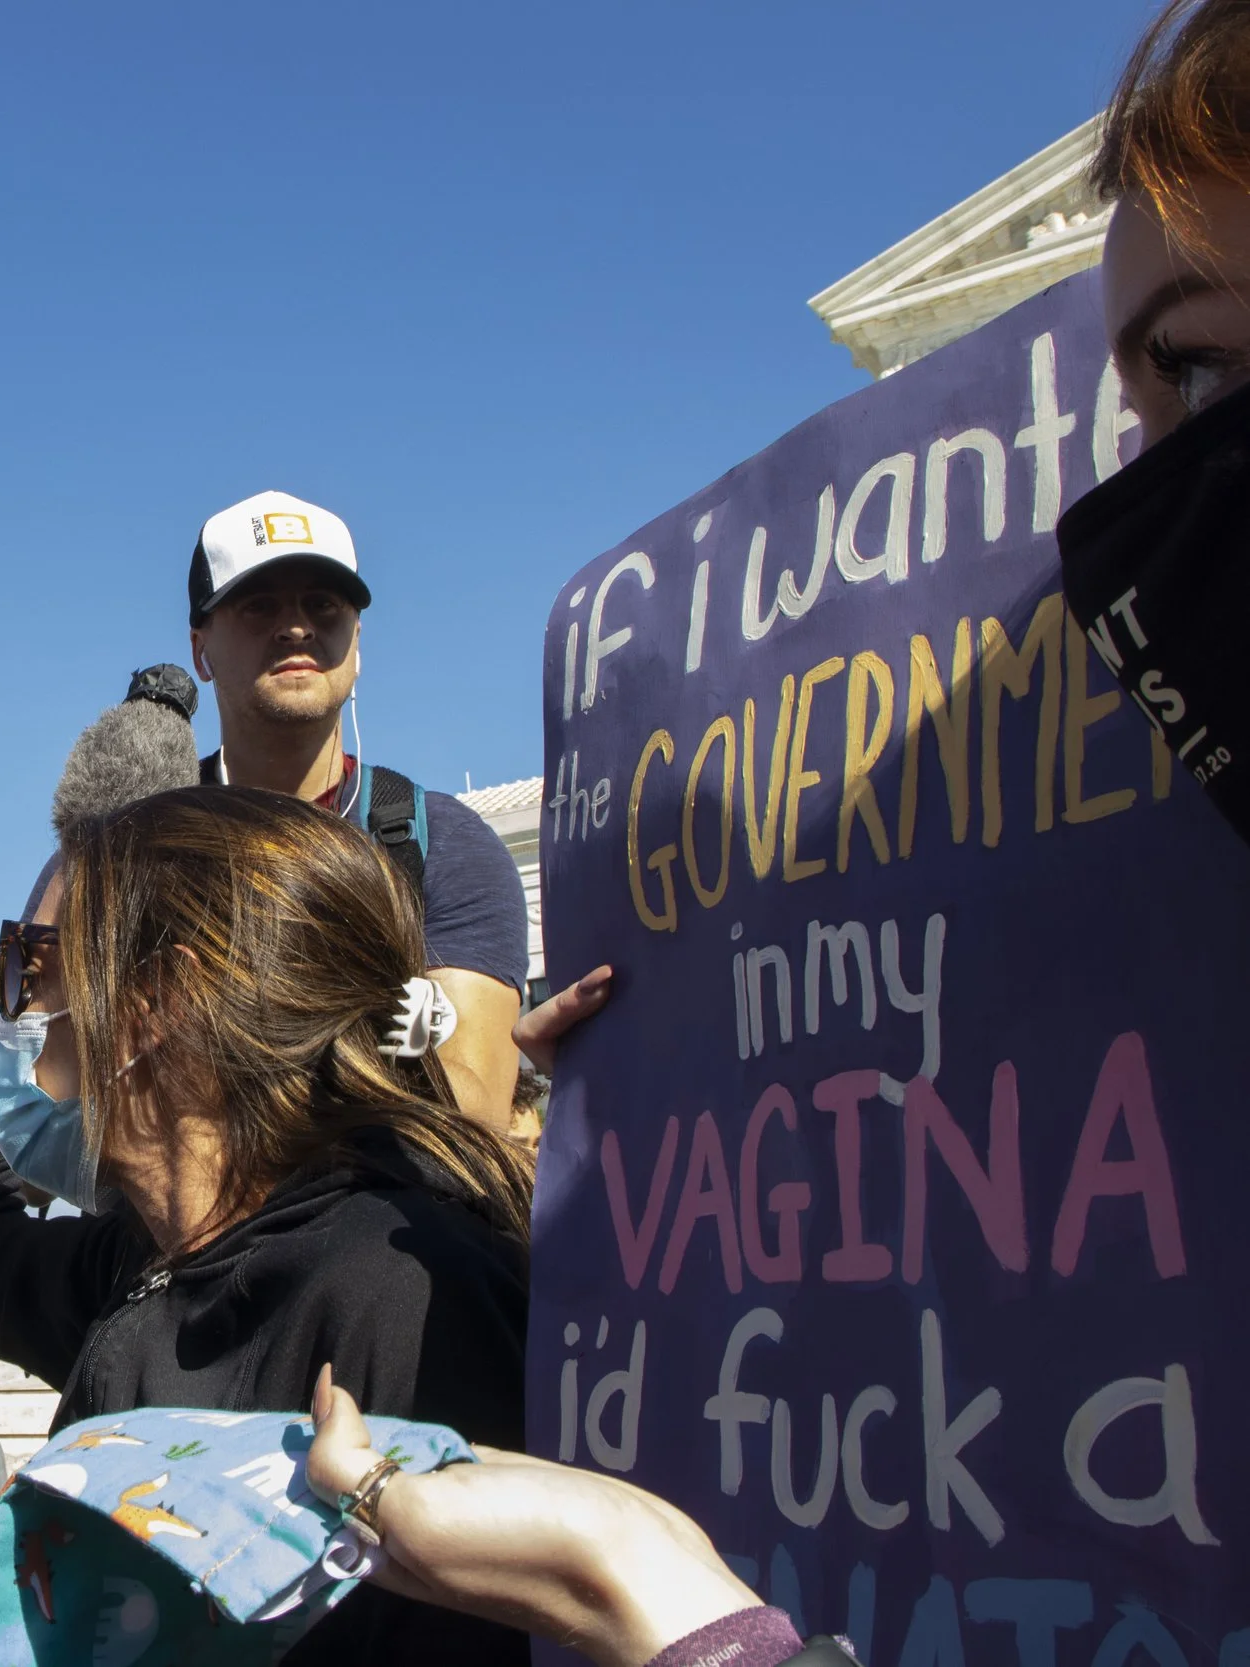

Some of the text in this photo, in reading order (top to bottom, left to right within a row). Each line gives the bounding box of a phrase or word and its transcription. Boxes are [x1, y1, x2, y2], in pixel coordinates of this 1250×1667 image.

[562, 551, 655, 721] if
[684, 511, 712, 673] i
[549, 750, 611, 843] the
[627, 592, 1171, 932] GOVERNME
[600, 1031, 1187, 1295] VAGINA
[558, 1307, 1222, 1548] i'd fuck a
